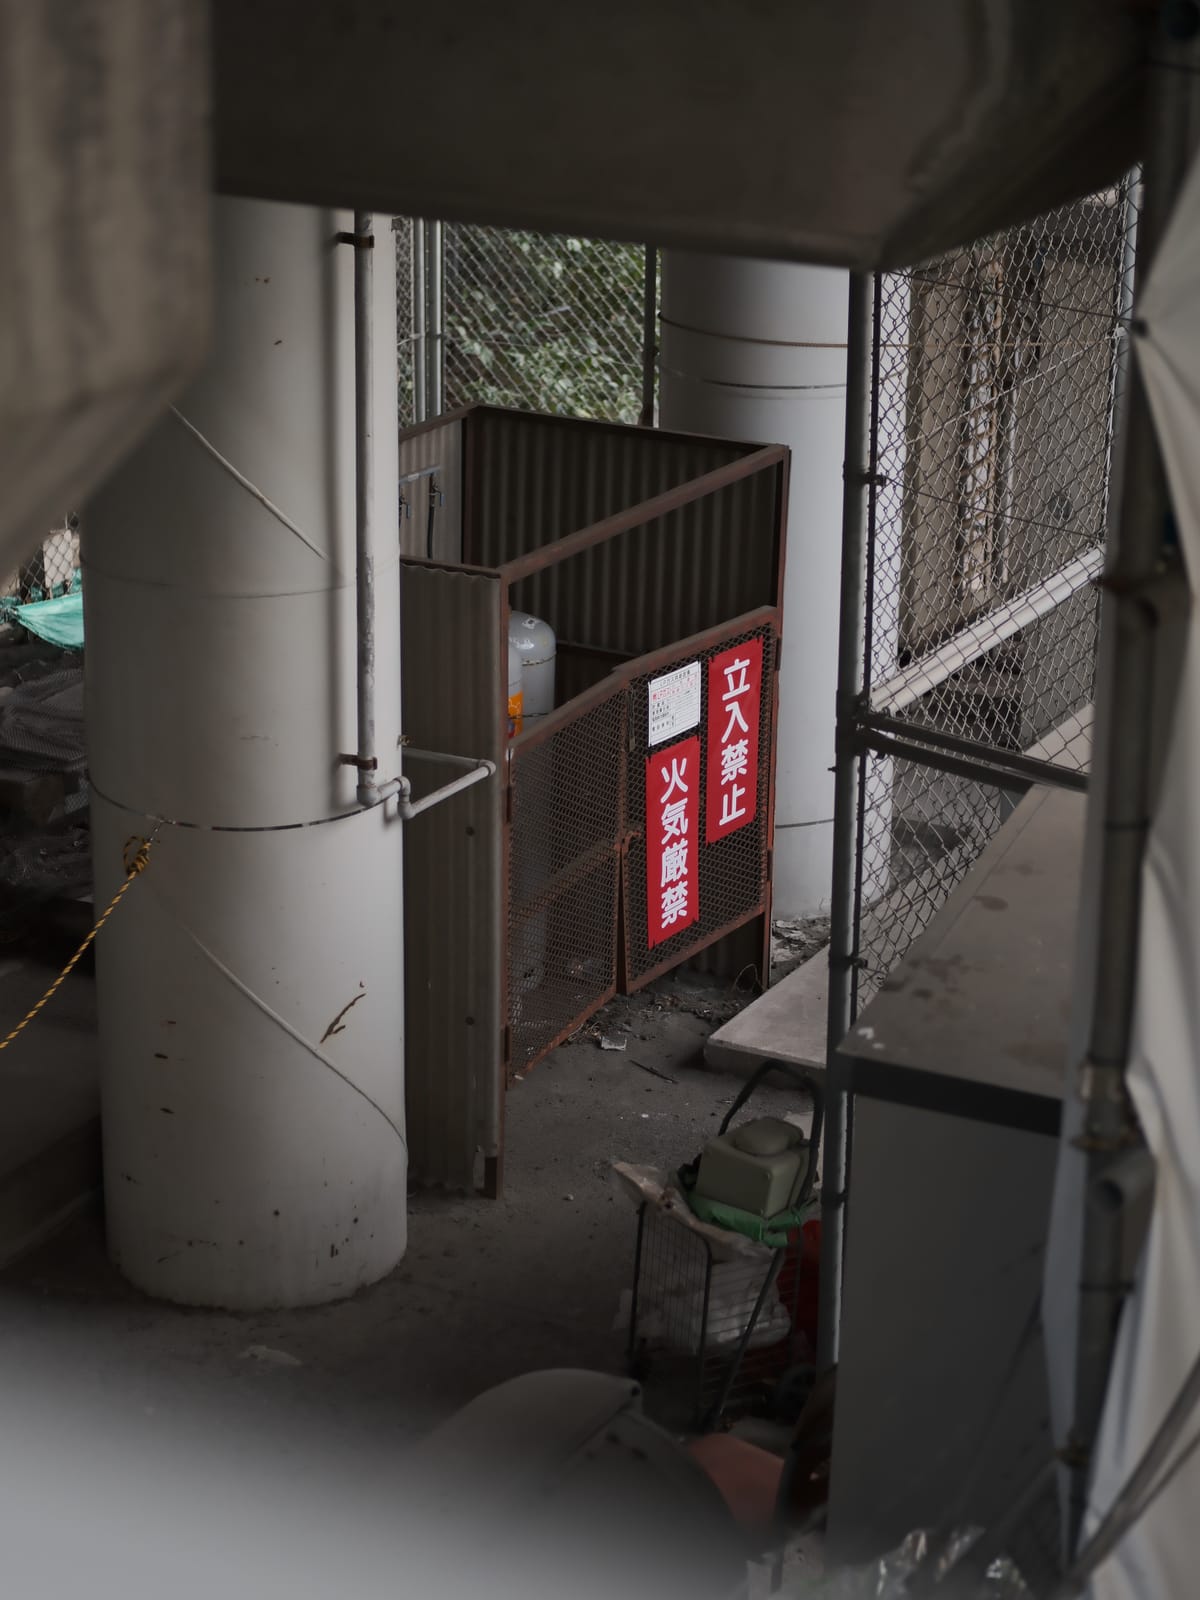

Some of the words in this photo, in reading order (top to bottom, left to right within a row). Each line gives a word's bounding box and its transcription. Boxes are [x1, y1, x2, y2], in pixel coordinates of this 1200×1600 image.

[719, 658, 750, 825] 立入禁止
[660, 757, 688, 928] 火気厳禁
